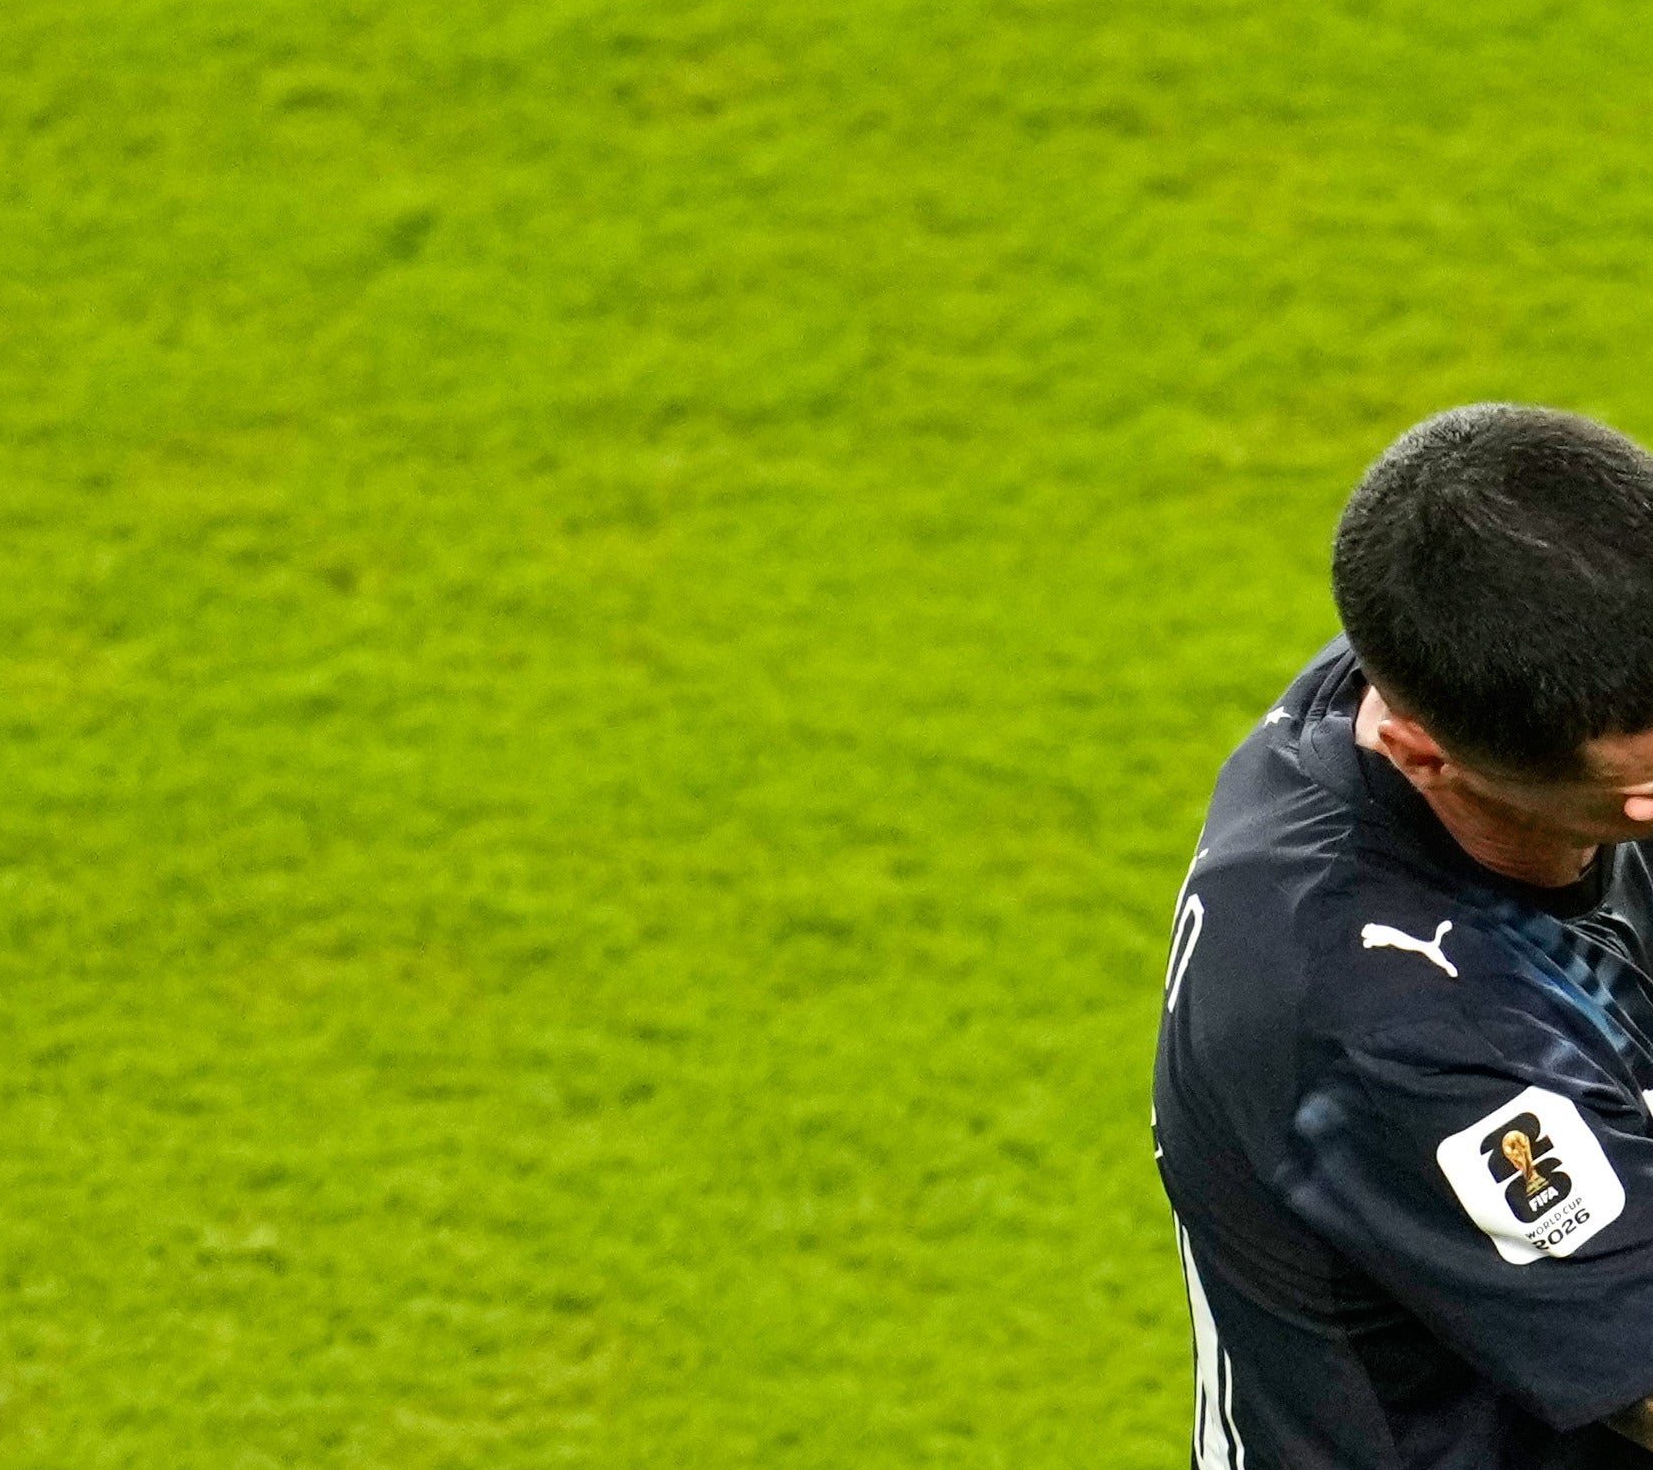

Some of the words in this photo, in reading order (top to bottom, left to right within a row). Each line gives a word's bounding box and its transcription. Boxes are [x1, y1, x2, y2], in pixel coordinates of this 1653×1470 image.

[1525, 1212, 1562, 1239] WORLD
[1562, 1197, 1582, 1214] CUP
[1528, 1186, 1559, 1212] FIFA
[1532, 1208, 1590, 1250] 2026
